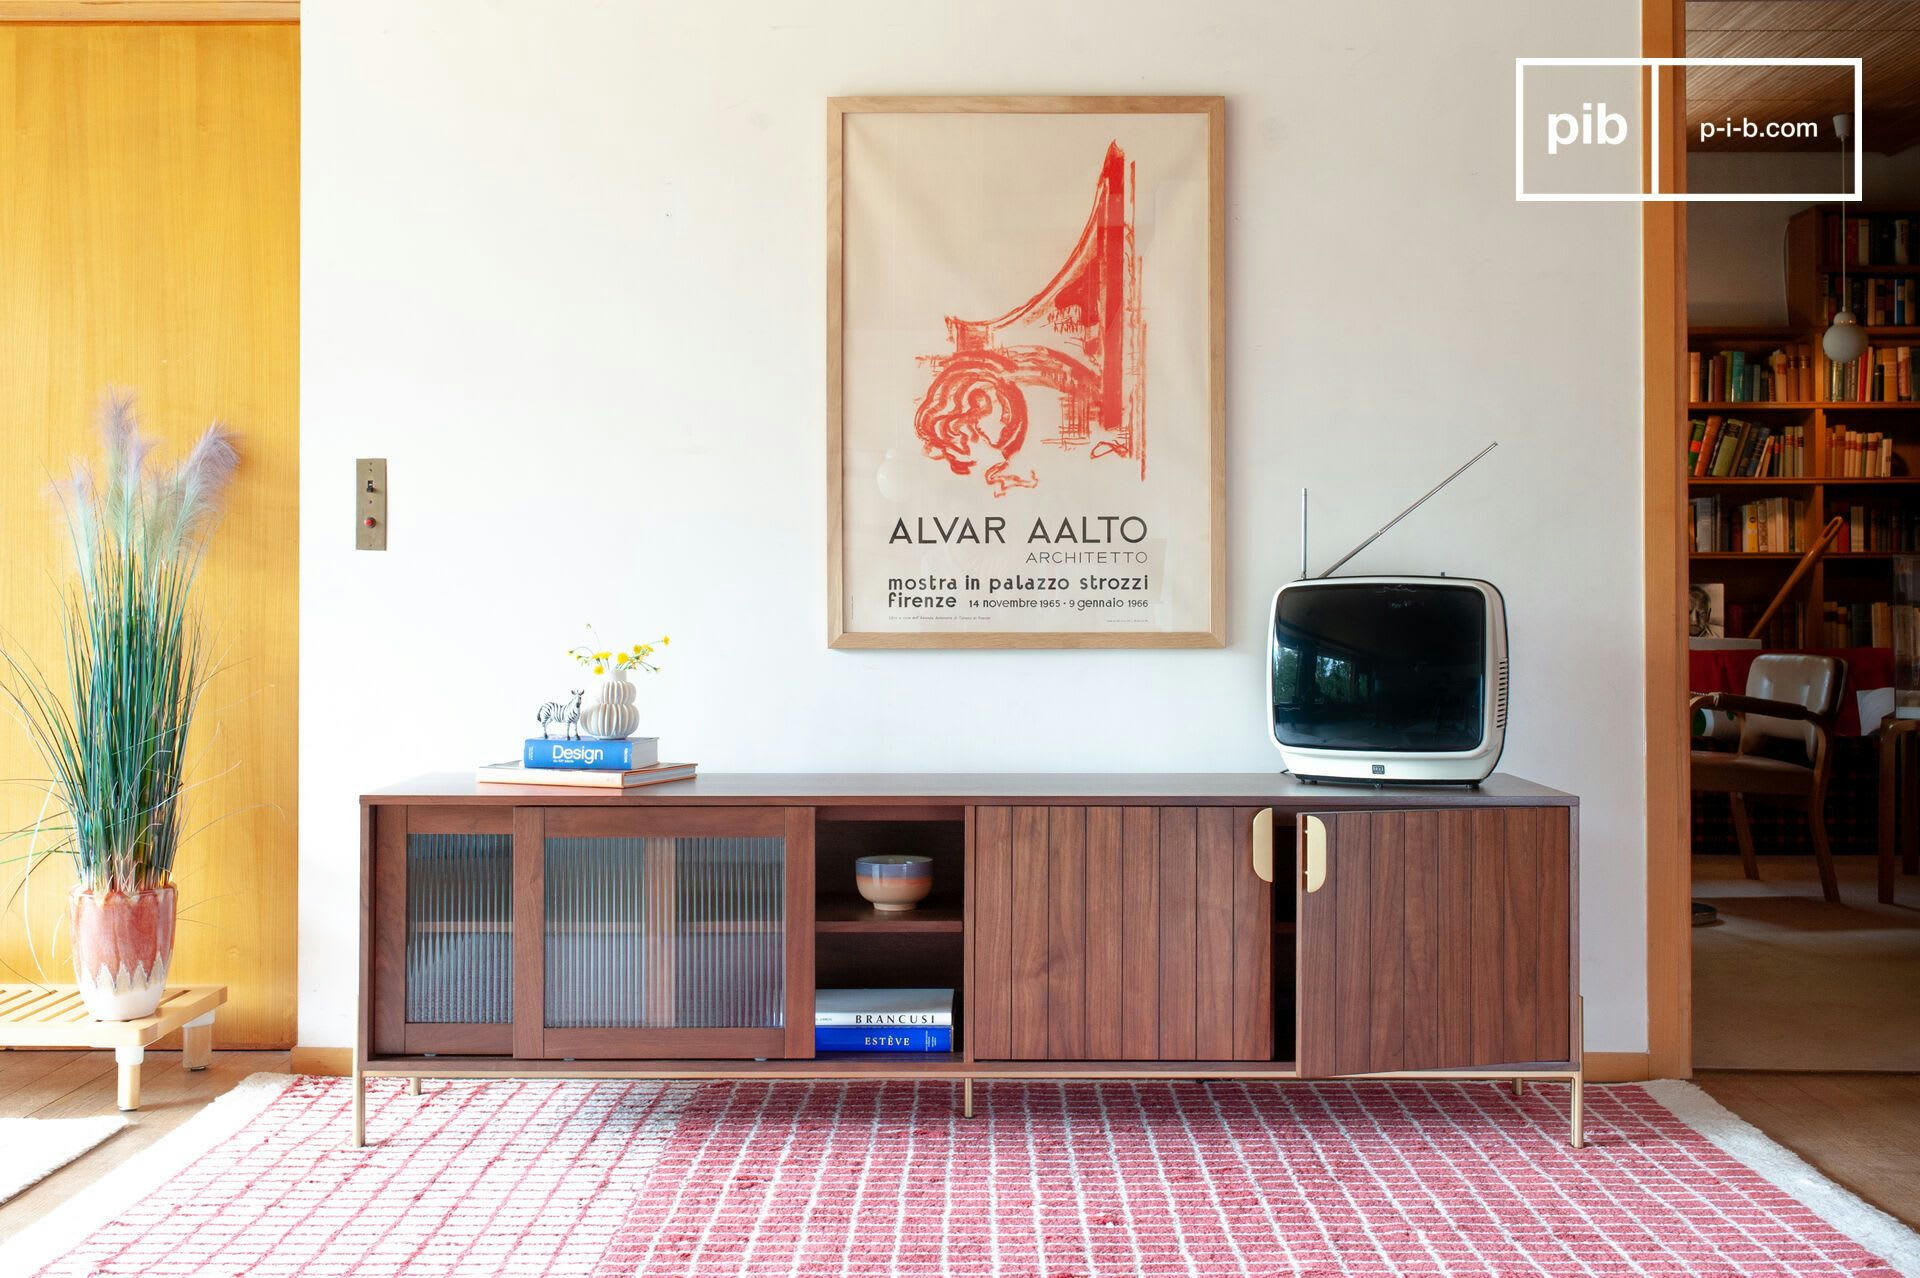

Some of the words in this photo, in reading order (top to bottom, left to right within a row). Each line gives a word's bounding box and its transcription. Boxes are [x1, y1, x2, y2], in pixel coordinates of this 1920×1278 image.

[888, 516, 1006, 544] ALVAR
[1027, 516, 1148, 544] AALTO
[1025, 551, 1148, 564] ARCHITETTO
[888, 575, 957, 590] mostra
[965, 575, 980, 590] in
[989, 575, 1070, 593] palazzo
[1079, 575, 1149, 590] strozzi
[888, 592, 957, 608] firenze
[969, 600, 980, 608] 14
[983, 598, 1037, 608] novembre
[1040, 600, 1061, 608] 1965
[1069, 600, 1076, 608] 9
[1077, 597, 1124, 611] gennaio
[1128, 600, 1149, 608] 1966
[552, 744, 604, 764] Design
[855, 1014, 935, 1024] BRANCUSI
[865, 1035, 910, 1046] ESTÈVE
